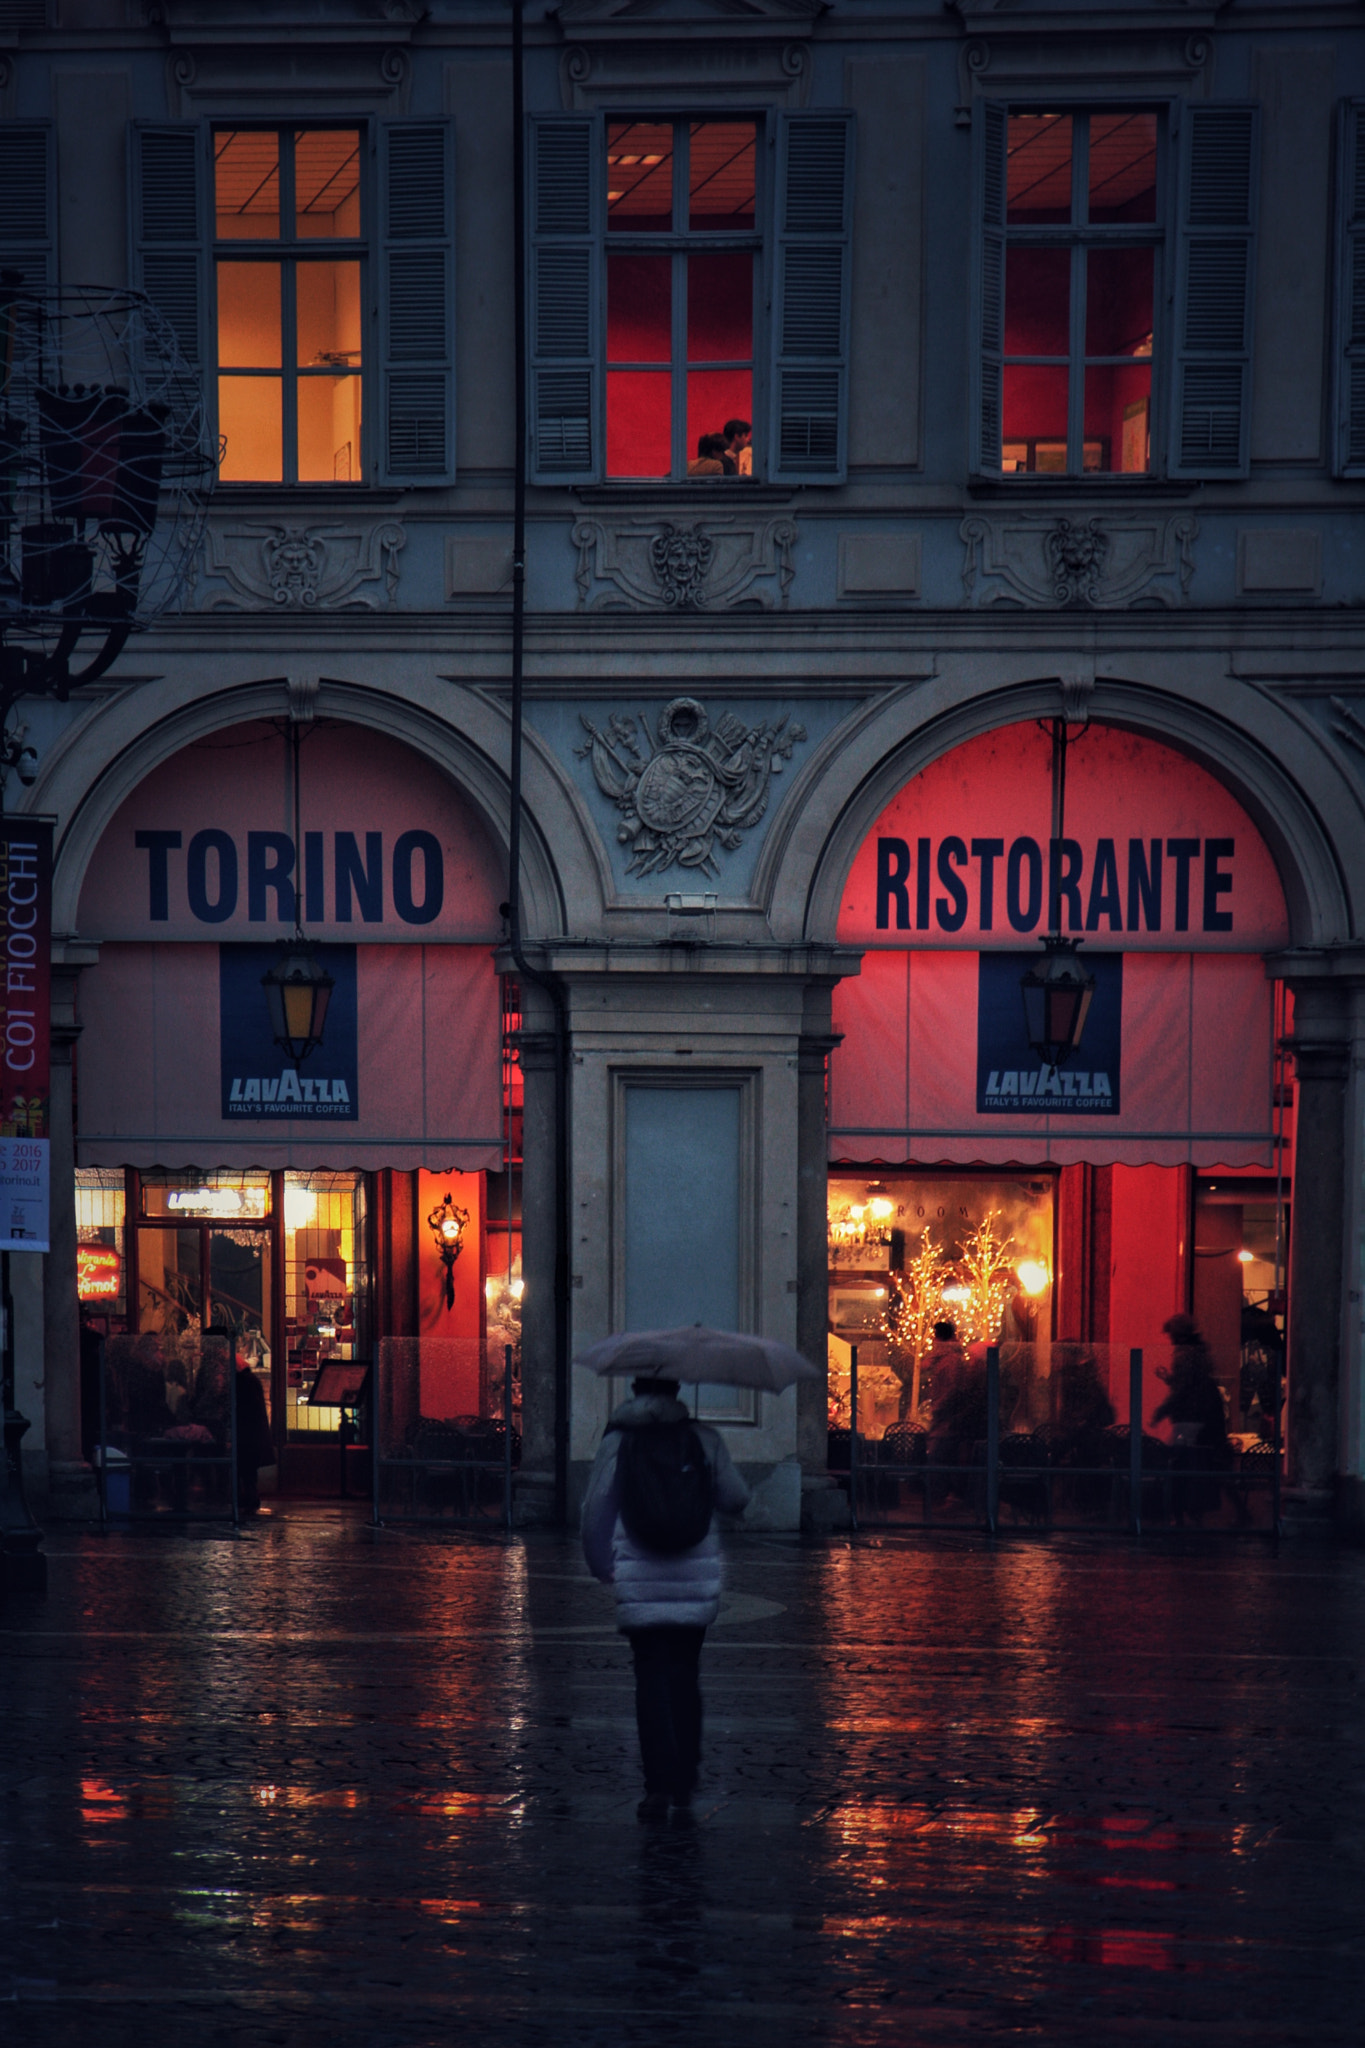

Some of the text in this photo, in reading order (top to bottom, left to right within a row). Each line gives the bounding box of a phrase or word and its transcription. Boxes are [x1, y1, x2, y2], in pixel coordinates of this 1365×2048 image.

[134, 828, 444, 924] TORINO
[876, 835, 1235, 933] RISTORANTE
[5, 841, 38, 1071] COI FIOCCHI
[229, 1069, 350, 1103] LAVAZZA
[984, 1062, 1112, 1097] LAVAZZA
[229, 1103, 351, 1113] ITALY'S FAVOURITE COFFEE
[984, 1097, 1113, 1108] ITALY'S FAVOURITE COFFEE
[12, 1144, 42, 1158] 2016
[12, 1158, 41, 1172] 2017
[77, 1250, 116, 1266] storante
[77, 1275, 118, 1300] fernot
